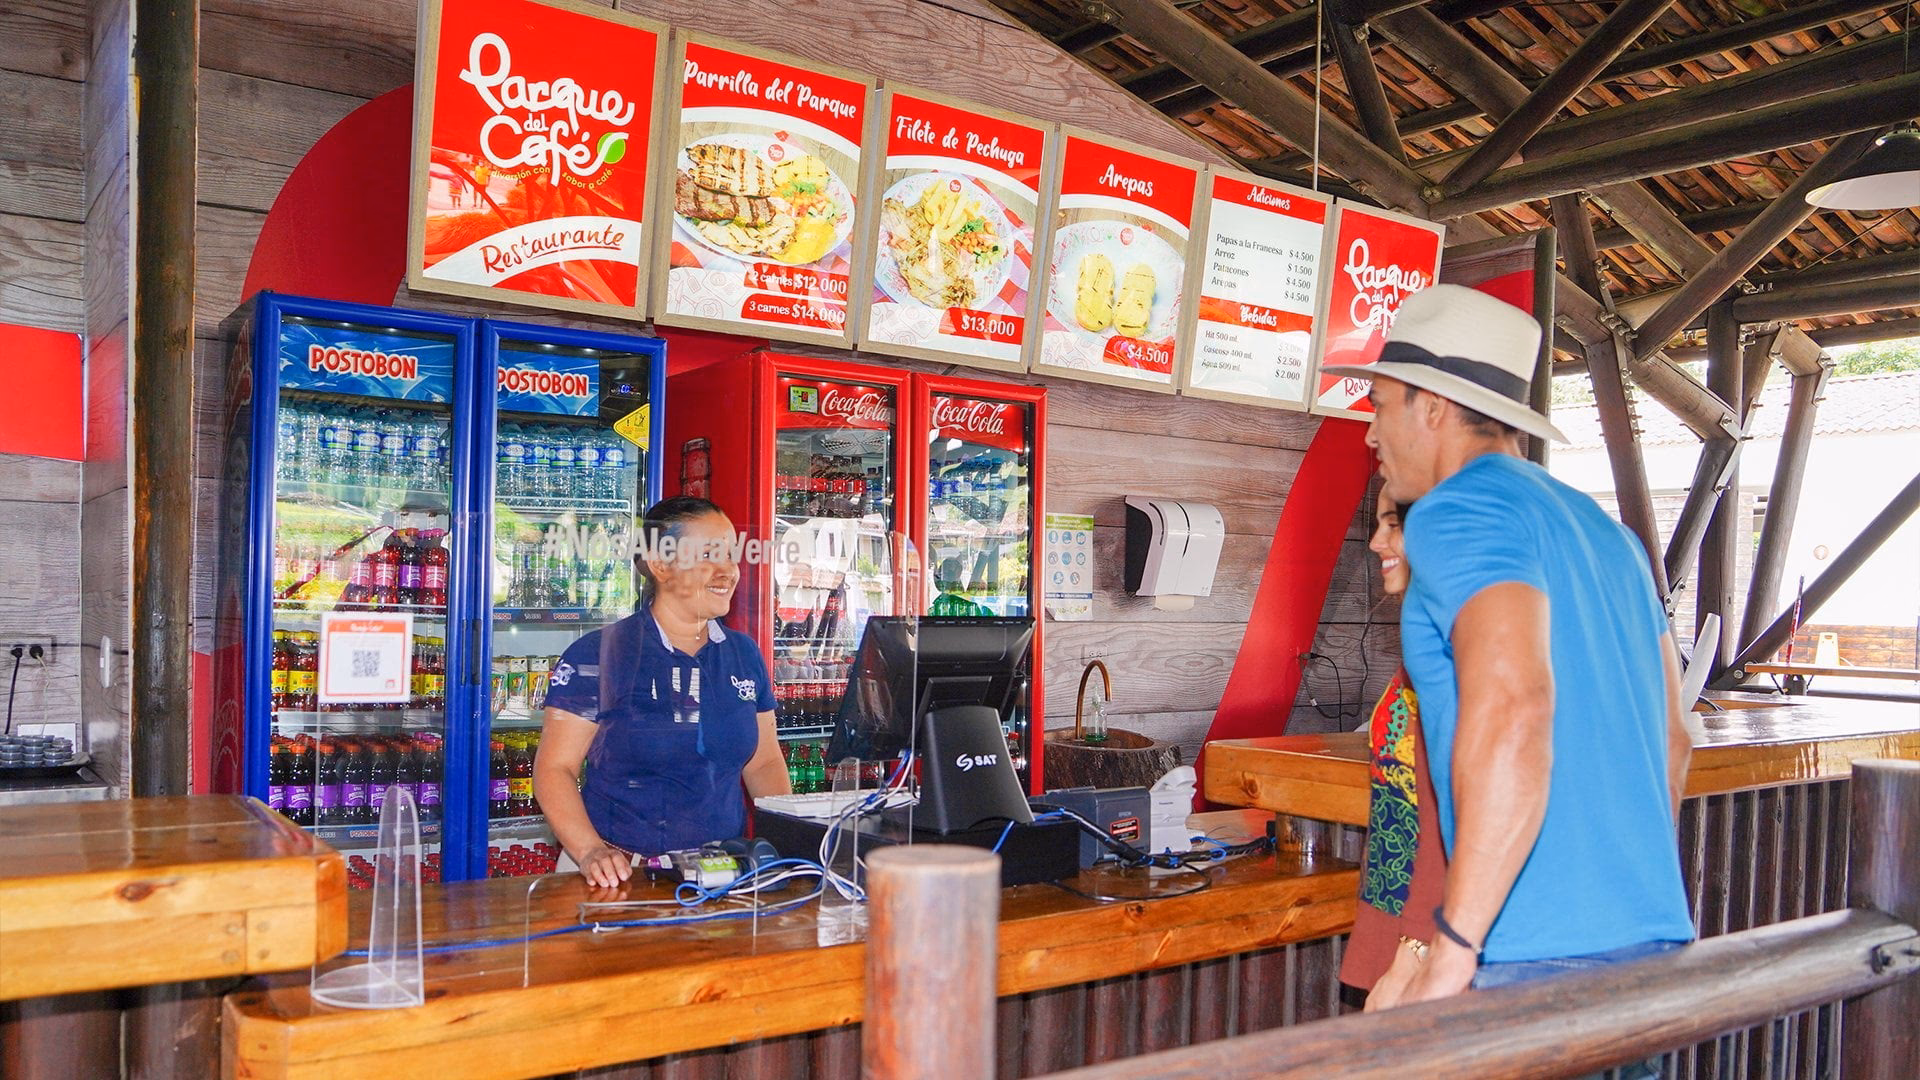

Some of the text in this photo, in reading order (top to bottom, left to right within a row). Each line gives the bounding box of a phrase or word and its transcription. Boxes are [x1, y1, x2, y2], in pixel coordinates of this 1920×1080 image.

[459, 32, 635, 135] Parque
[683, 59, 857, 119] Parrilla del Parque
[523, 113, 549, 133] del
[480, 114, 629, 187] Café
[896, 115, 1024, 169] Filete de Pechuga
[533, 166, 551, 175] con
[561, 171, 586, 189] sabor
[1099, 163, 1154, 197] Arepas
[1247, 186, 1291, 211] Adiciones
[479, 223, 625, 274] Restaurante
[1214, 247, 1236, 260] Arroz
[1216, 233, 1238, 246] Papas
[1244, 239, 1252, 249] la
[1252, 241, 1283, 256] Francesa
[1213, 262, 1250, 277] Patacones
[1343, 237, 1426, 302] Parque
[752, 271, 848, 295] 2 carnes $12.000
[1211, 276, 1237, 289] Arepas
[749, 300, 846, 324] 3 carnes $14.000
[1240, 304, 1277, 327] Bebidas
[961, 315, 1015, 337] $13.000
[310, 345, 417, 380] POSTOBON
[1127, 343, 1169, 365] $4.500
[497, 368, 589, 397] POSTOBON
[544, 524, 800, 570] #NosAlegraVerte
[974, 754, 998, 766] SAT
